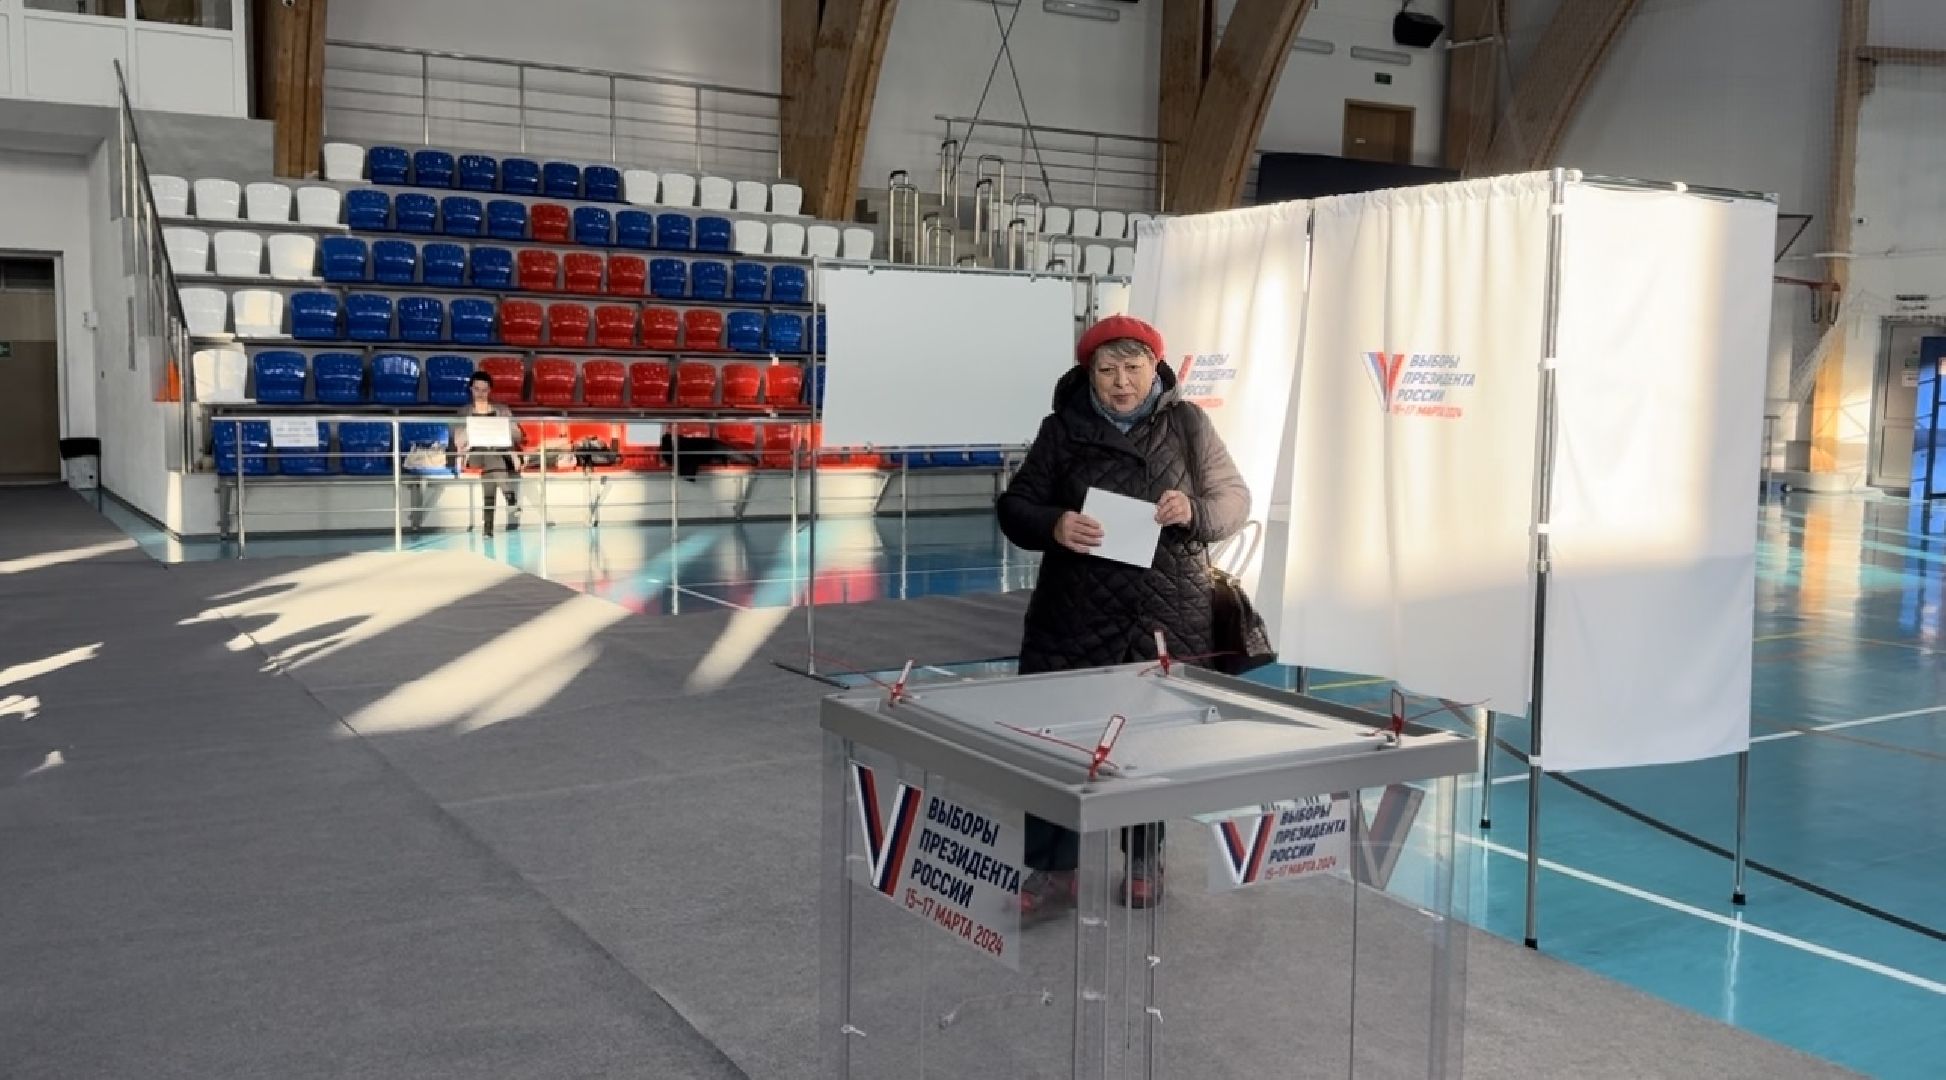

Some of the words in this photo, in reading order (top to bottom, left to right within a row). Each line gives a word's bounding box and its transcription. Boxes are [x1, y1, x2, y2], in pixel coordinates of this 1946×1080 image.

[1410, 354, 1460, 368] ВЫБОРЫ
[1402, 371, 1475, 386] ПРЕЗИДЕНТА
[1396, 388, 1446, 402] РОССИИ
[927, 796, 999, 847] ВЫБОРЫ
[1280, 803, 1332, 825] ВЫБОРЫ
[1274, 819, 1346, 844] ПРЕЗИДЕНТА
[919, 828, 1021, 895] ПРЕЗИДЕНТА
[1268, 843, 1316, 864] РОССИИ
[1288, 859, 1316, 875] МАРТА
[1316, 855, 1337, 870] 2024
[911, 859, 974, 908] РОССИИ
[933, 904, 972, 940] МАРТА
[973, 924, 1004, 958] 2024
